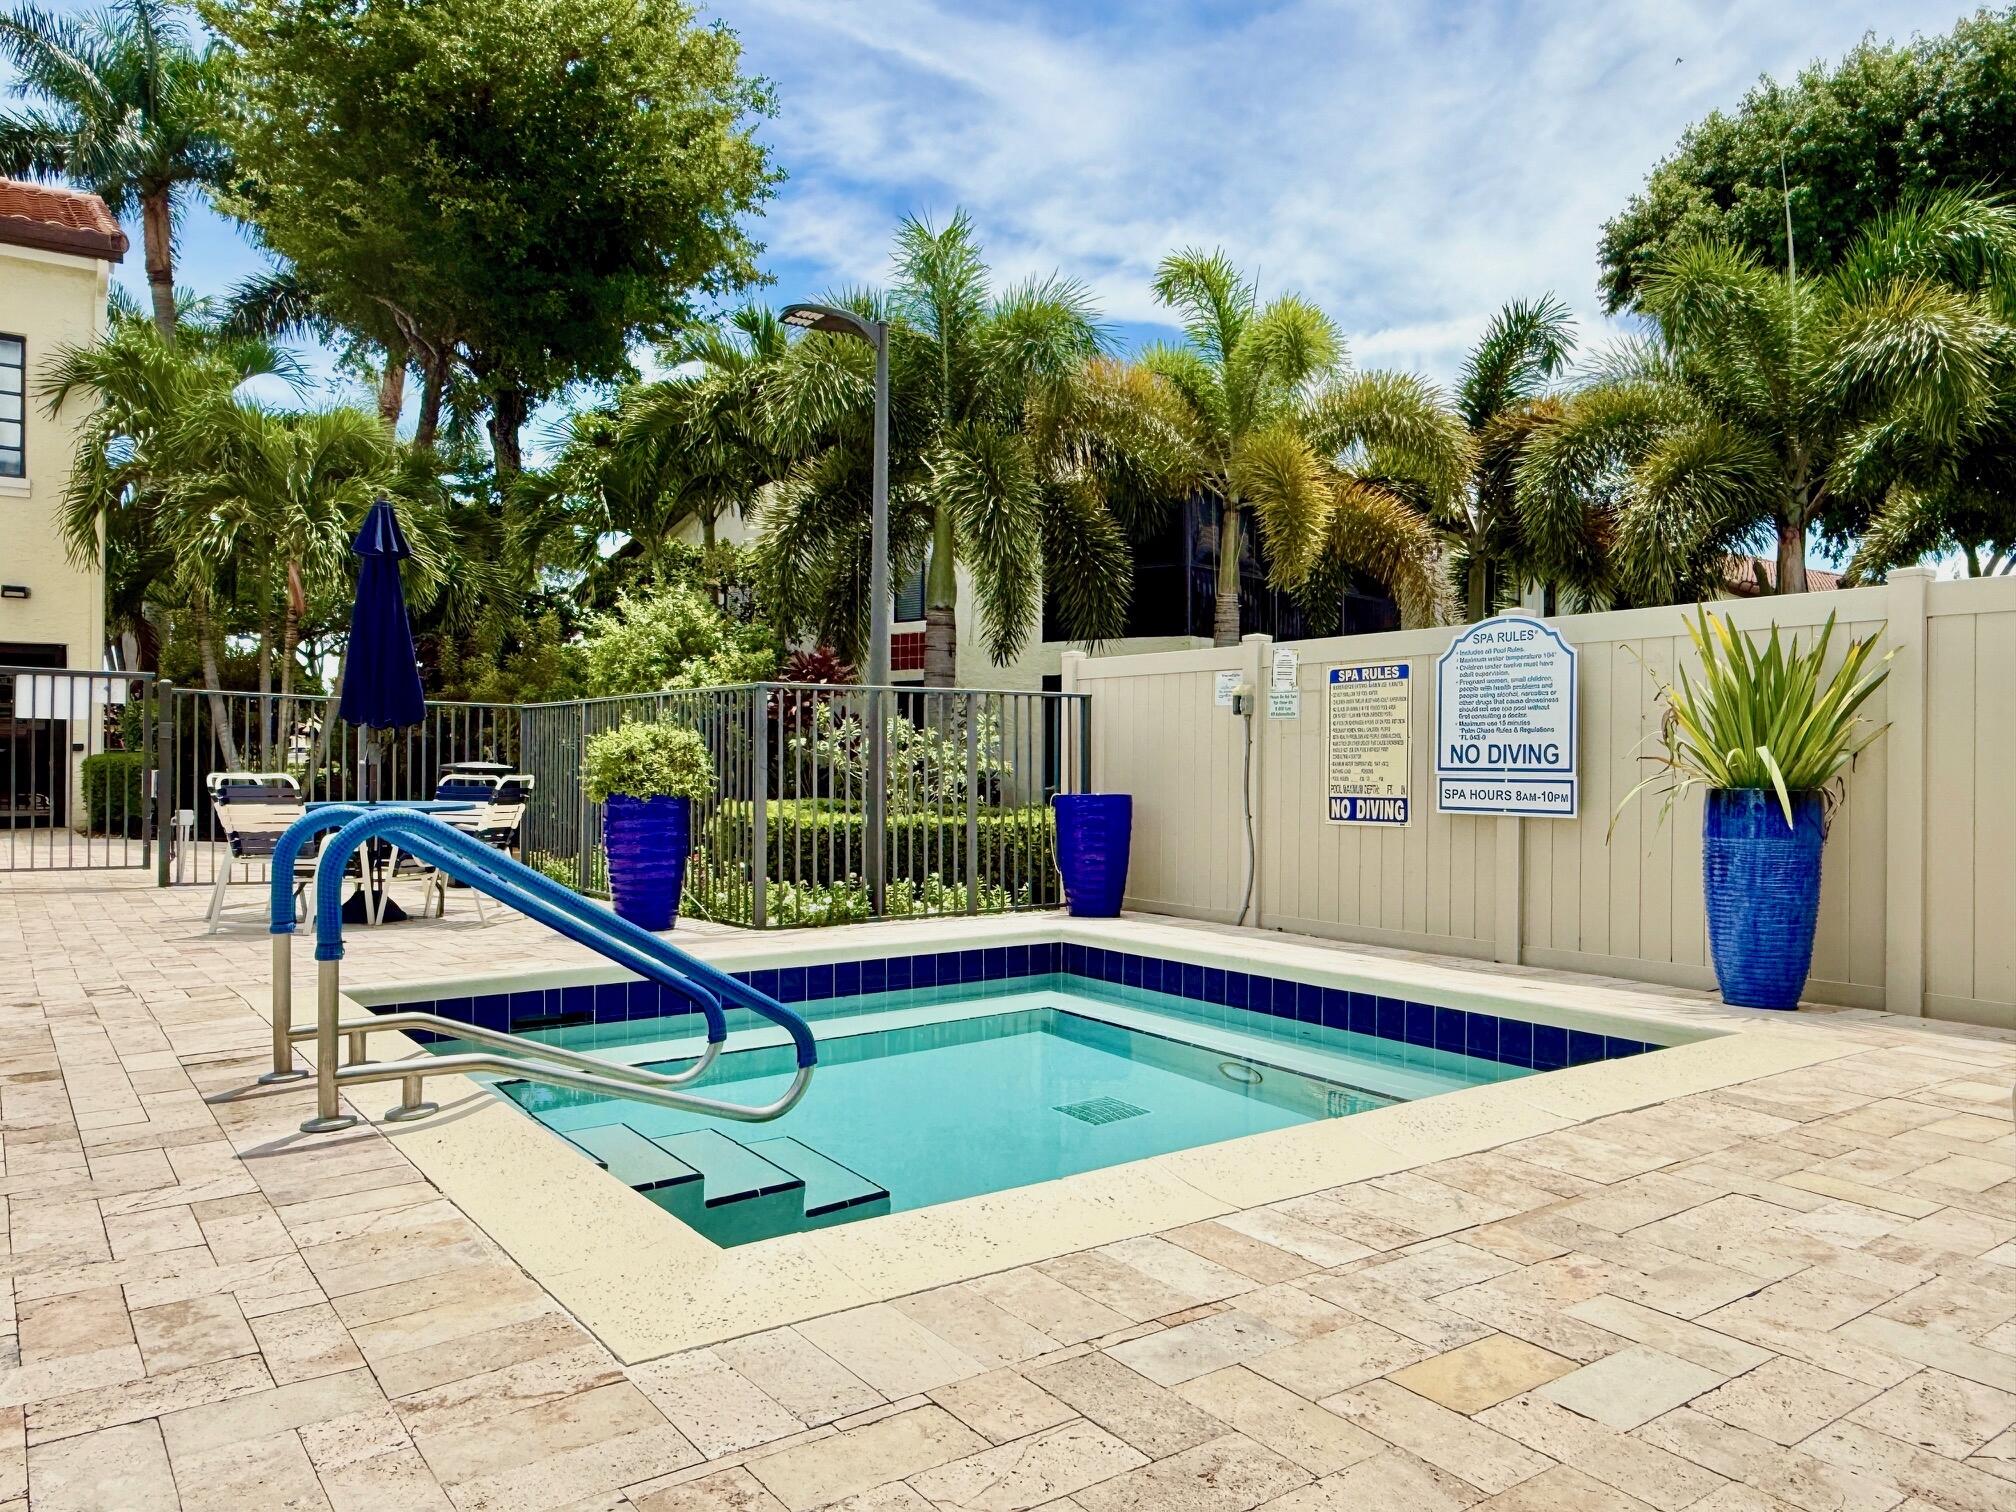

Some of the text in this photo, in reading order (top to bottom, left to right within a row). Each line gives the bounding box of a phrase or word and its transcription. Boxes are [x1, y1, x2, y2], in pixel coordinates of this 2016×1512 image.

[1473, 633, 1494, 644] SPA
[1338, 666, 1400, 682] SPA RULES
[1450, 744, 1559, 764] NO DIVING
[1444, 789, 1568, 802] SPA HOURS 8AM-10PM
[1331, 798, 1404, 820] NO DIVING
